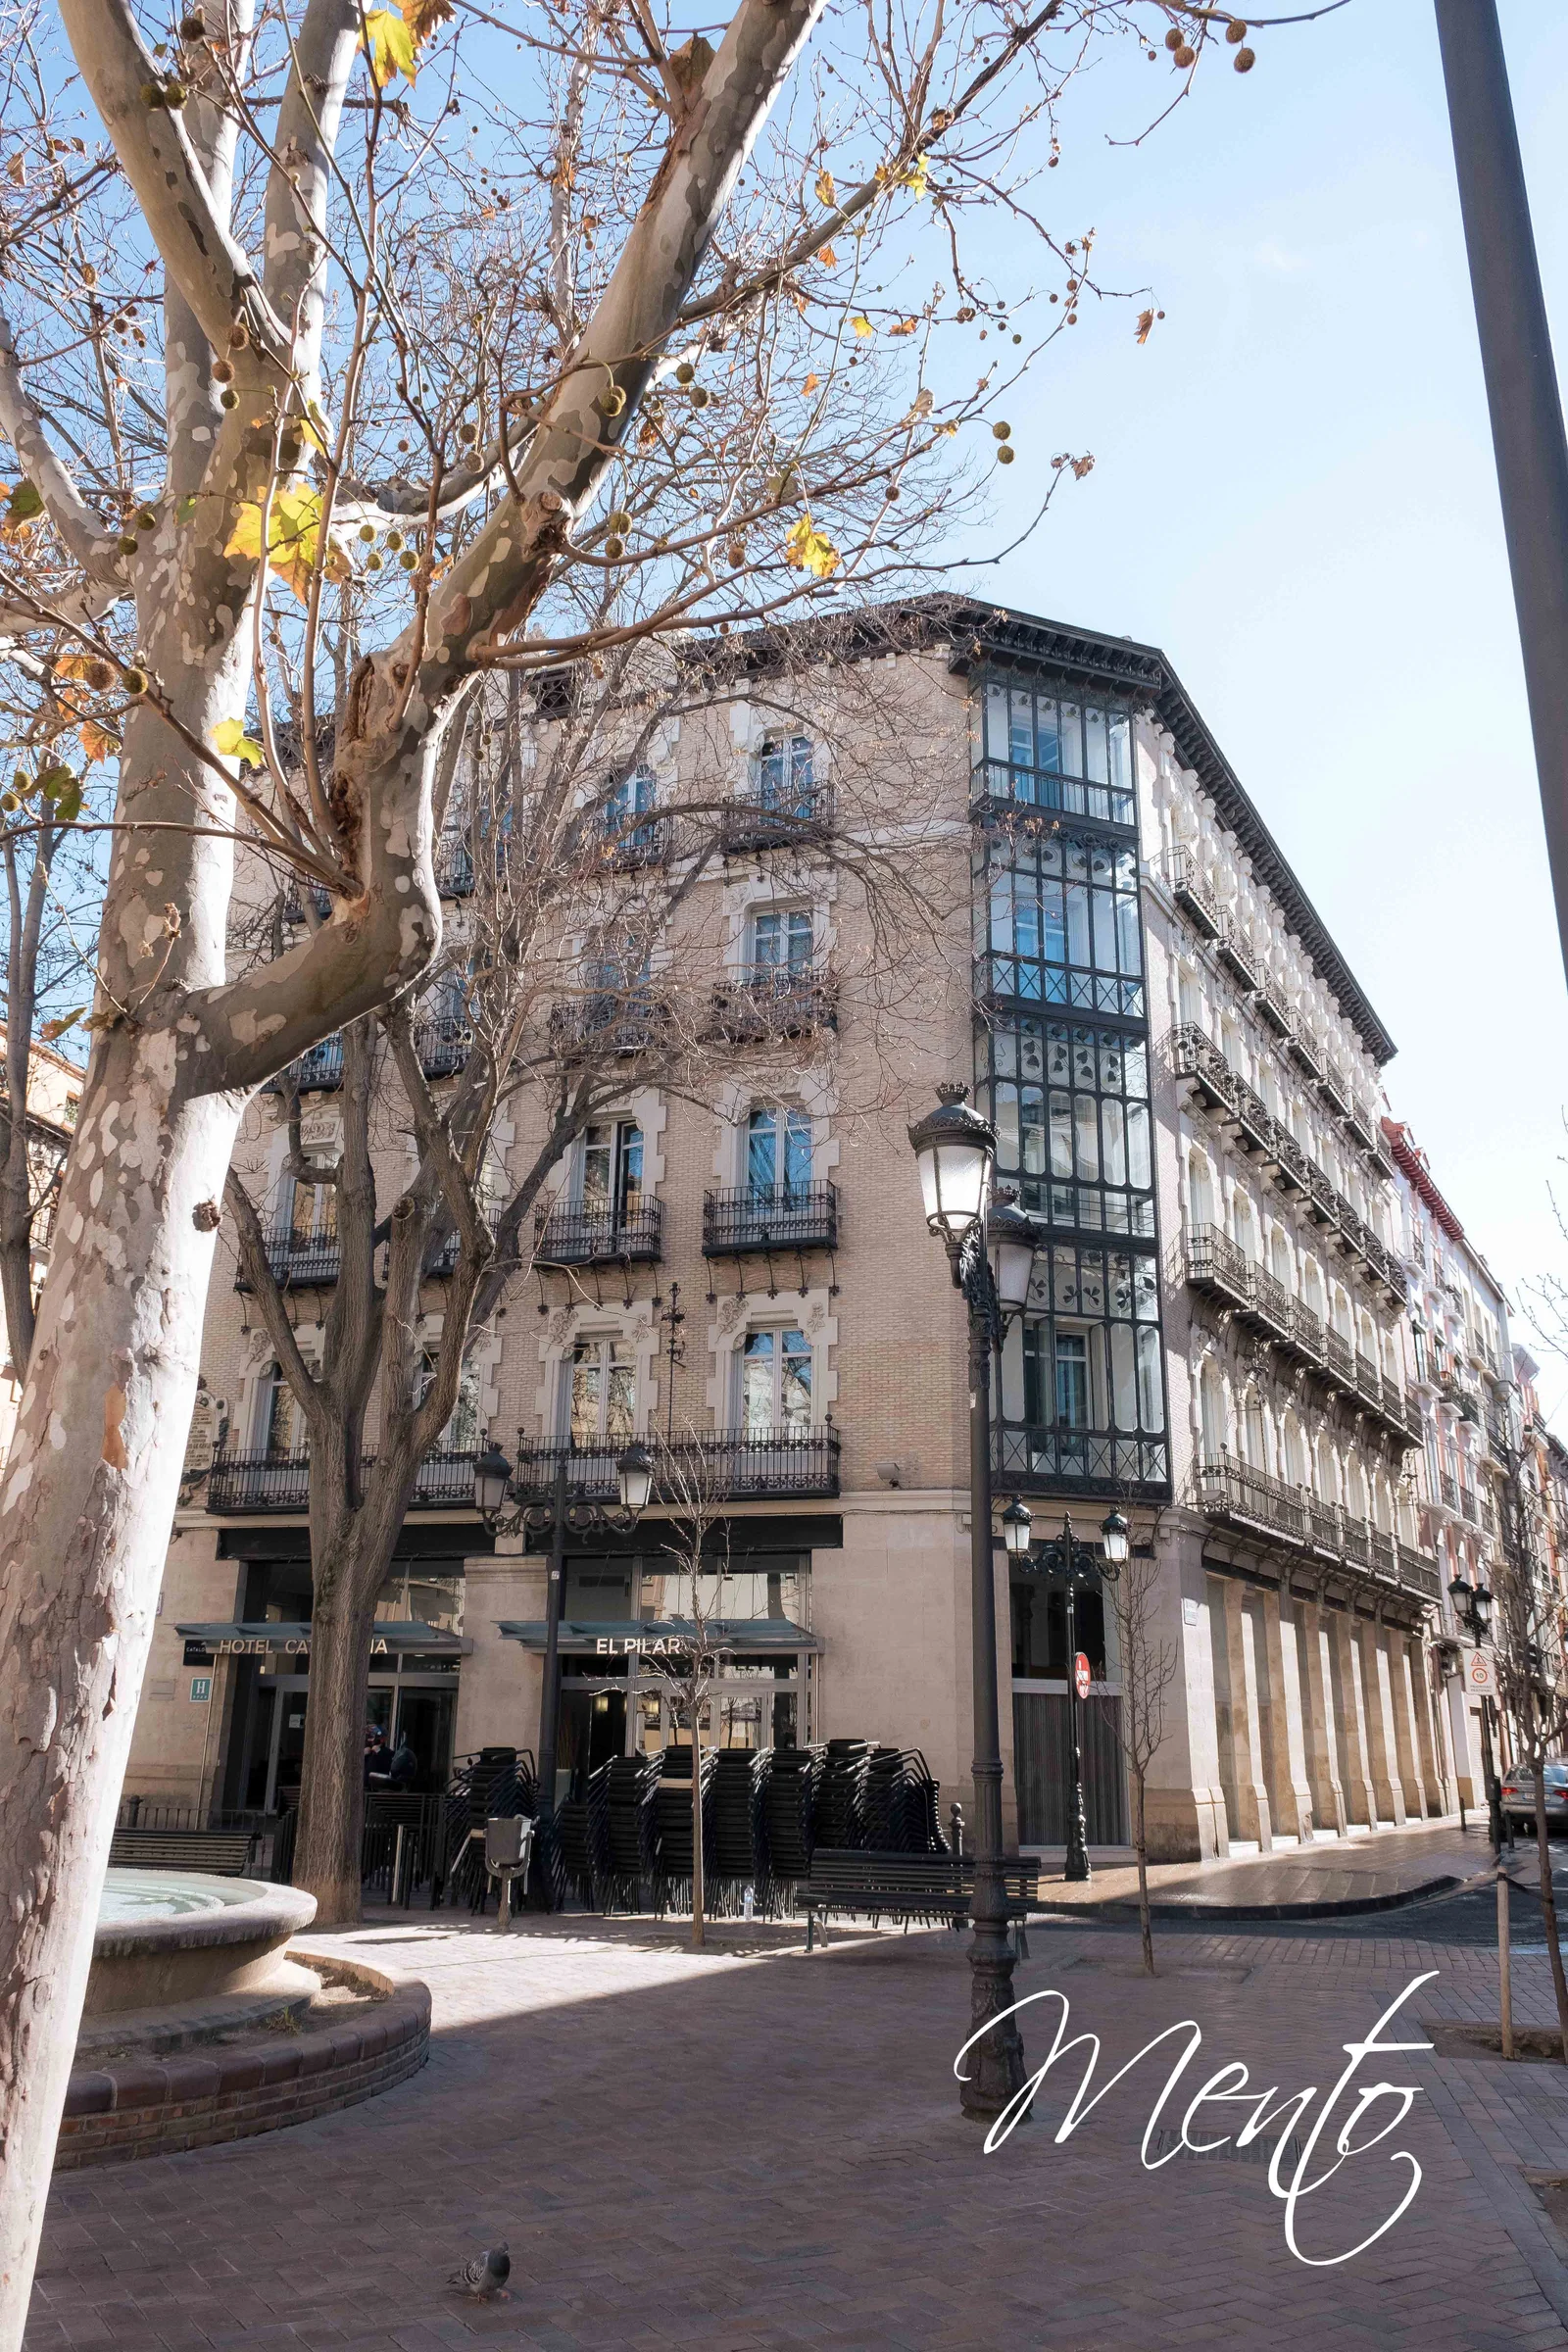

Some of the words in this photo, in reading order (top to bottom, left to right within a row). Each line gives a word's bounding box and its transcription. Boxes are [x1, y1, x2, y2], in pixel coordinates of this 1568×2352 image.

[219, 1639, 273, 1654] HOTEL
[596, 1638, 618, 1655] EL
[623, 1638, 680, 1655] PILAR
[196, 1681, 206, 1694] H
